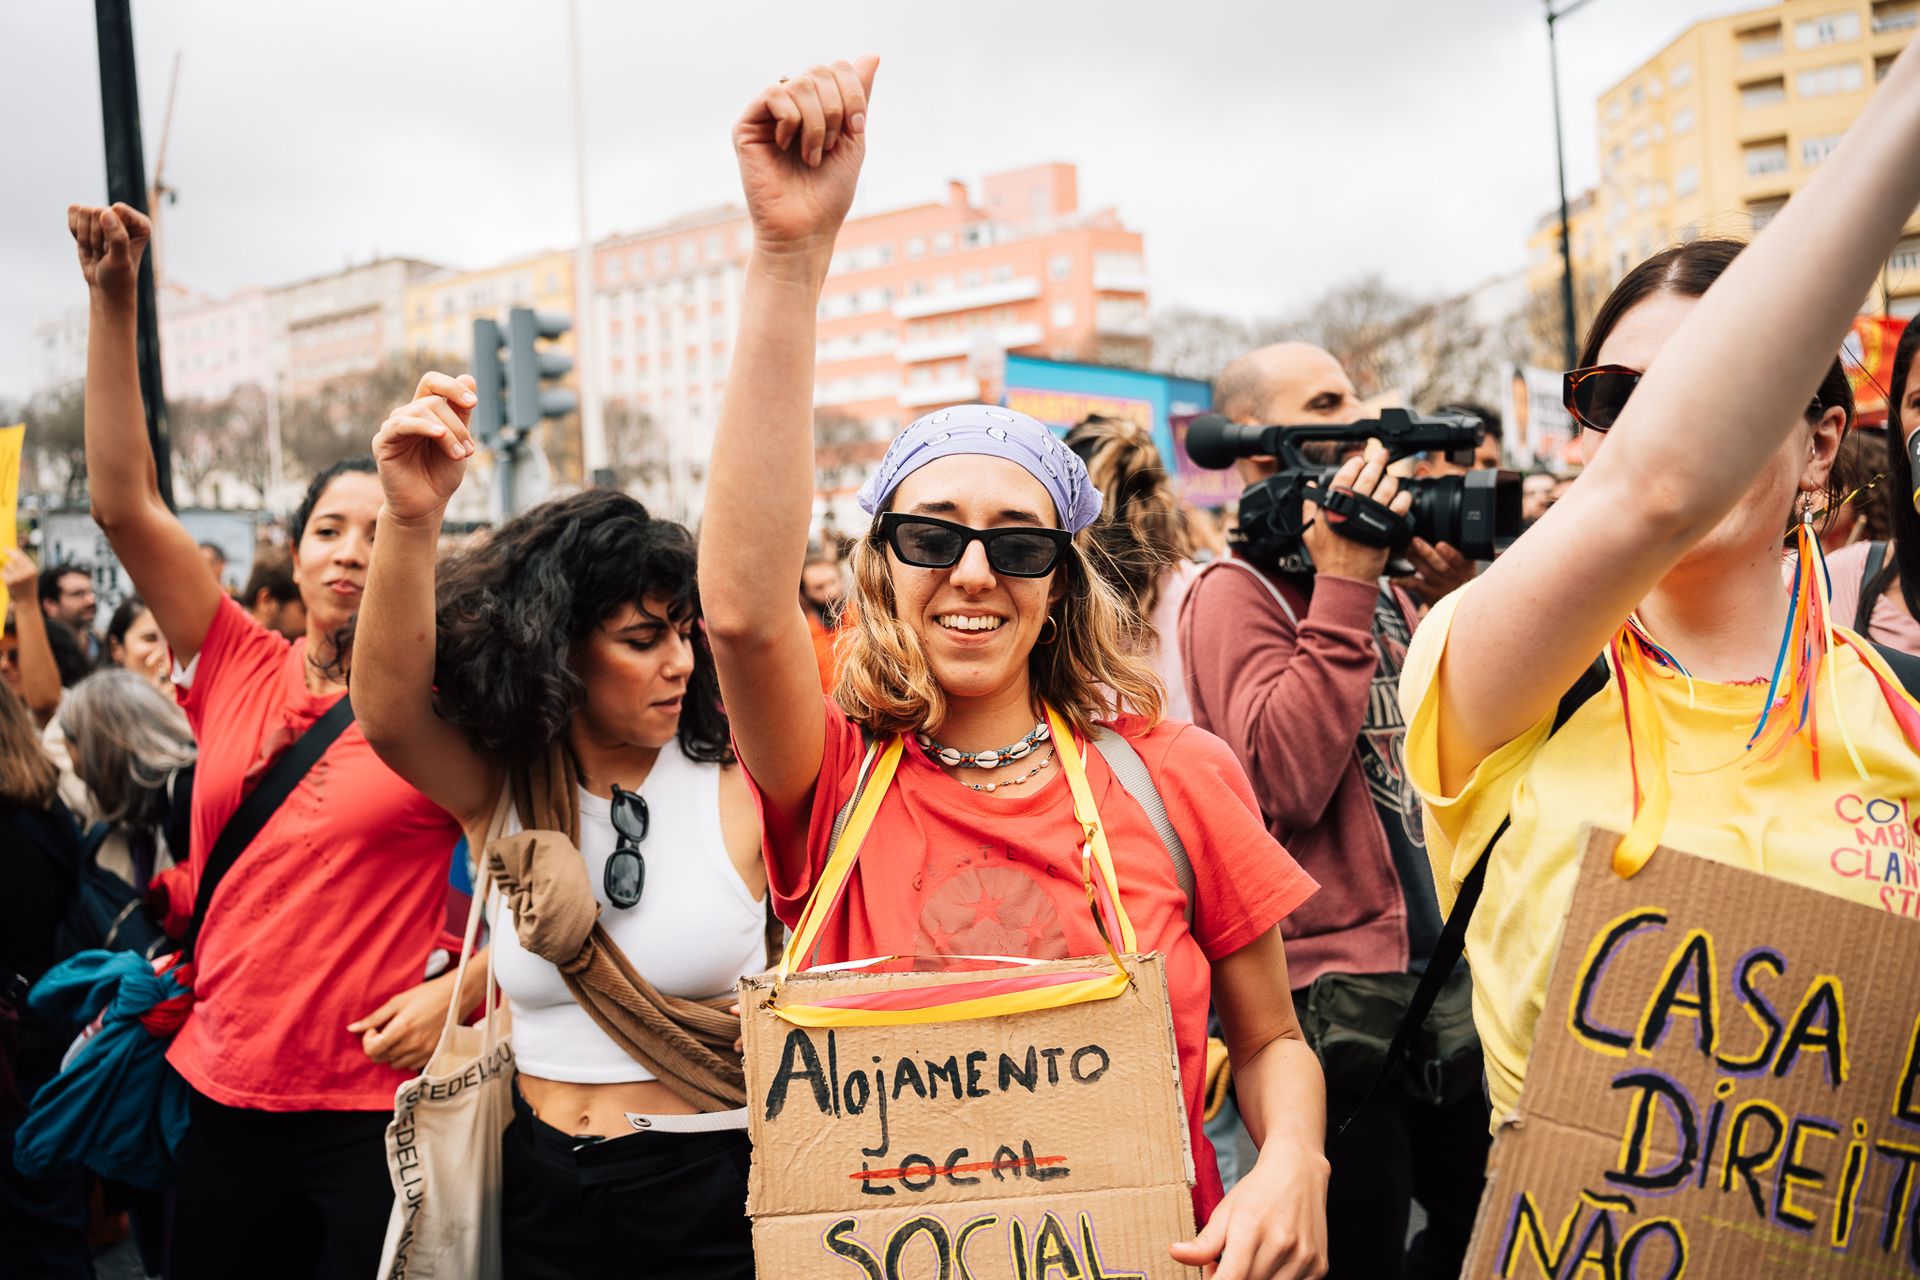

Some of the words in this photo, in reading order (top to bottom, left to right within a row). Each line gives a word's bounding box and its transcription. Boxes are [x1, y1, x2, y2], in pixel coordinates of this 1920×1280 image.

[1568, 906, 1850, 1092] CASA
[860, 1139, 1071, 1196] LOCAL
[1604, 1067, 1920, 1273] DiREiT
[822, 1209, 1148, 1280] SOCIAL
[1495, 1187, 1688, 1280] NÃO
